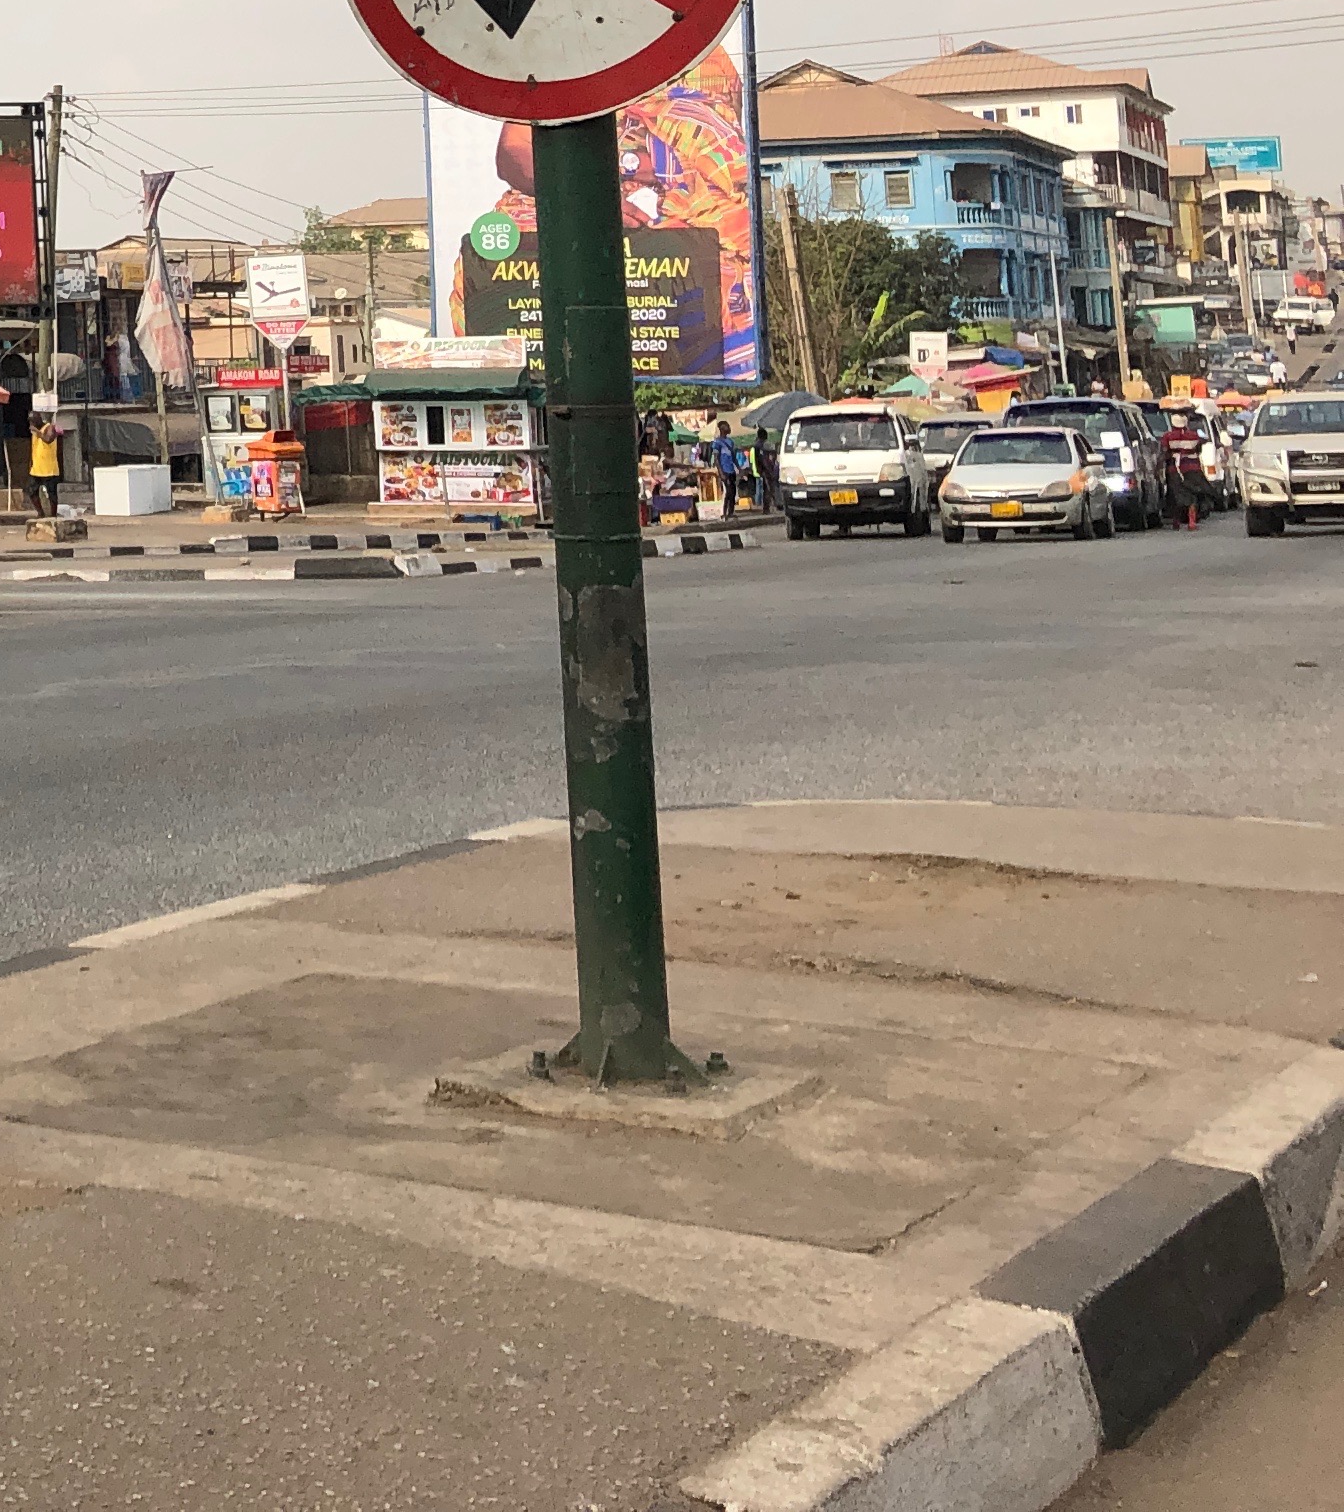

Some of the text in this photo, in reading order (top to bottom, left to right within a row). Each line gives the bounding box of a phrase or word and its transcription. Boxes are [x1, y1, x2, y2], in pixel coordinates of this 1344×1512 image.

[479, 224, 511, 234] AGED
[481, 233, 510, 250] 86
[630, 309, 667, 321] 2020
[639, 327, 680, 339] STATE
[631, 339, 668, 352] 2020
[220, 369, 280, 381] AMAKOM ROAD
